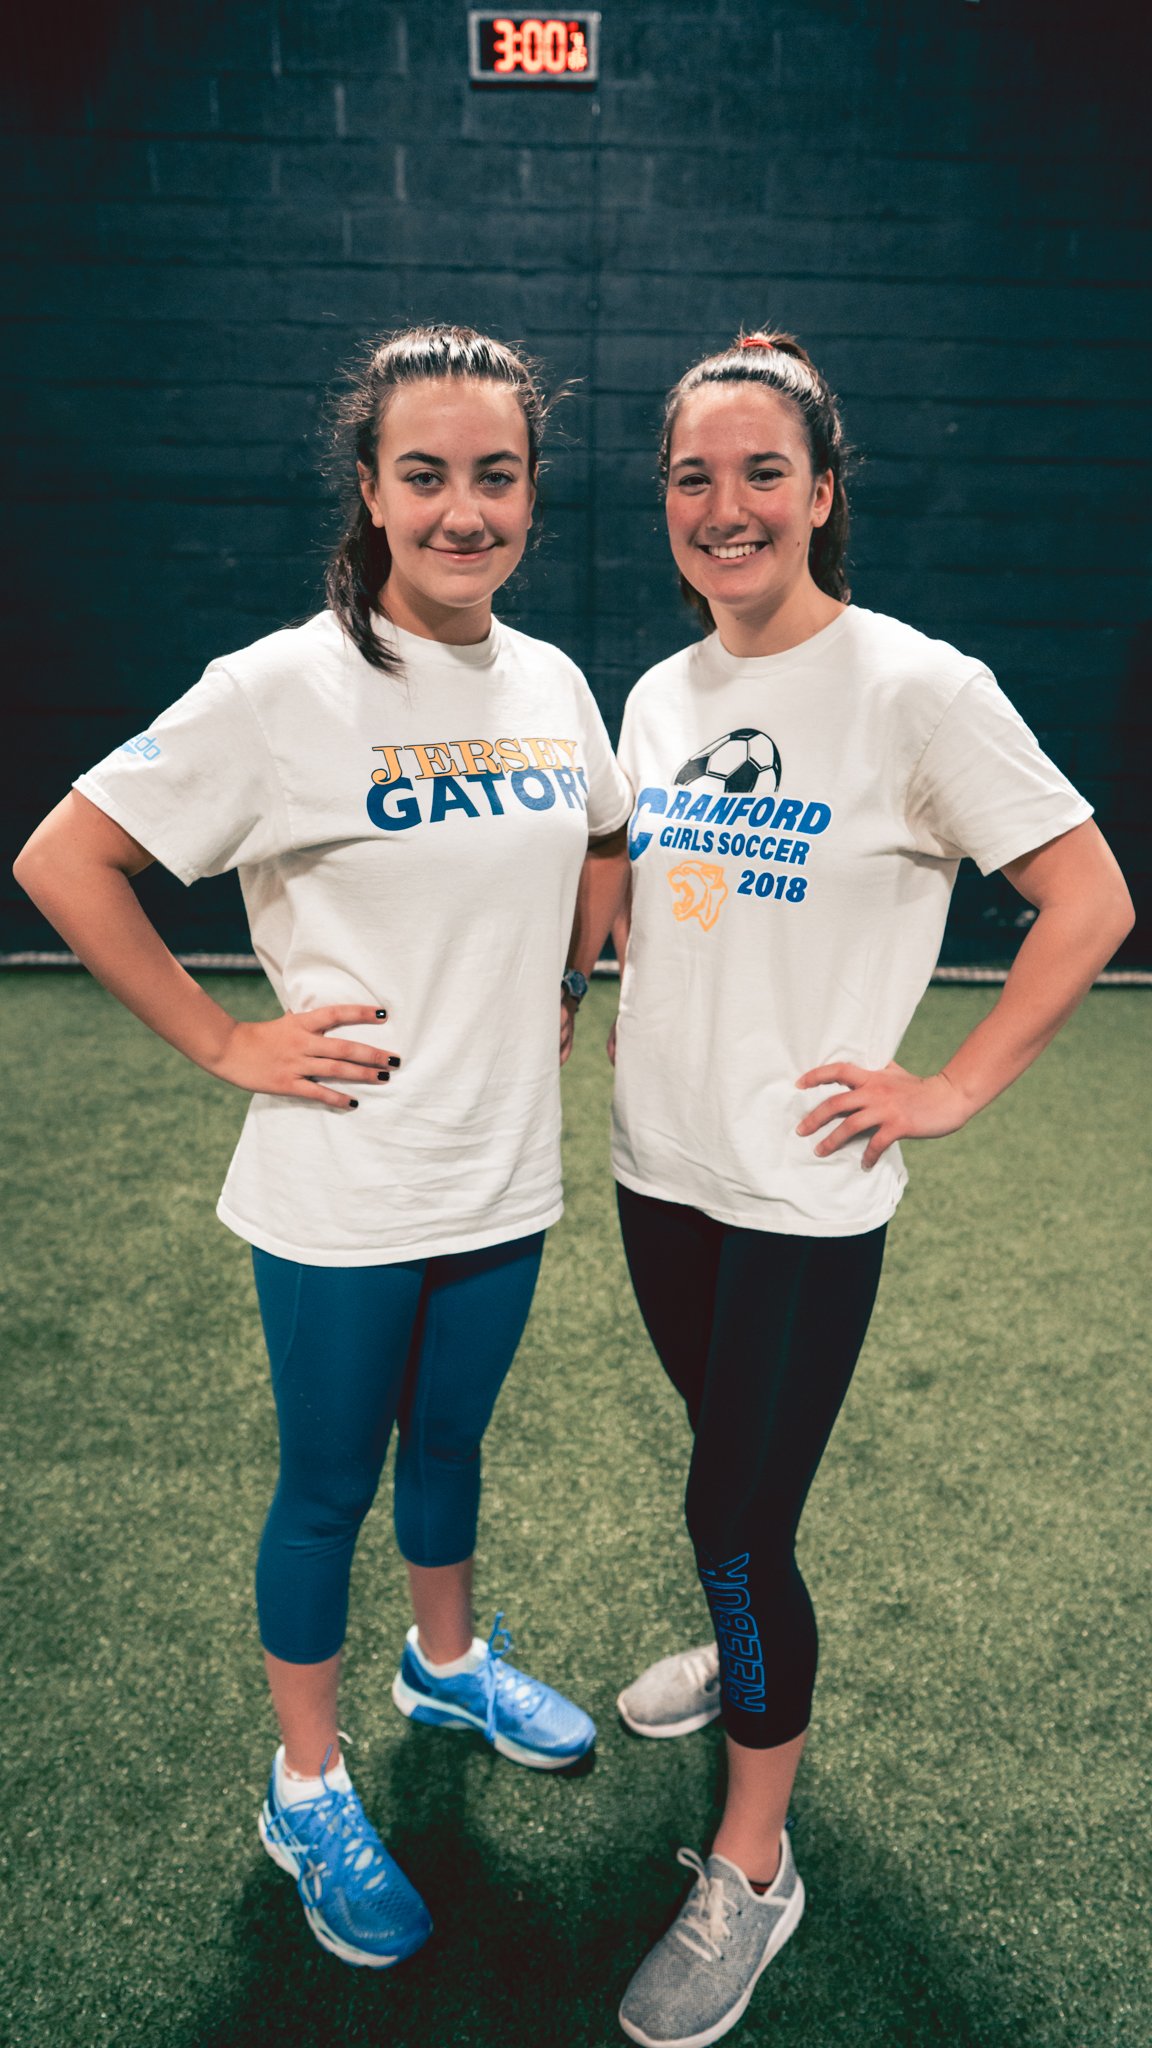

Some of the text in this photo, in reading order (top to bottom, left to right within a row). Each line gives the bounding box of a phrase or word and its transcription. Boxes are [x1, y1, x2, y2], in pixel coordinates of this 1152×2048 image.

[493, 18, 567, 74] 3:00
[371, 737, 583, 785] JERSEY
[628, 787, 832, 861] CRANFORD
[659, 826, 810, 865] GIRLS SOCCER
[737, 869, 808, 903] 2018
